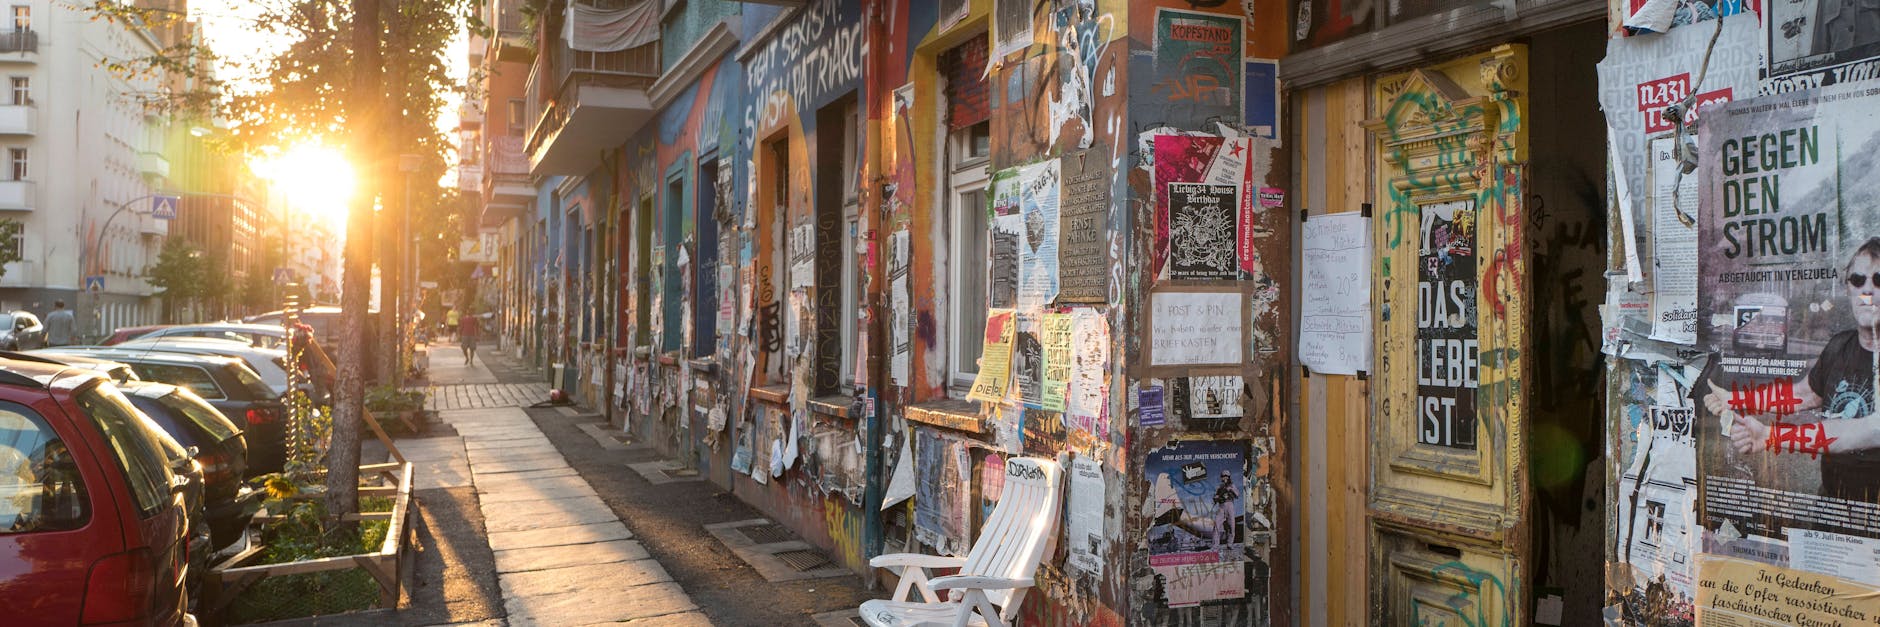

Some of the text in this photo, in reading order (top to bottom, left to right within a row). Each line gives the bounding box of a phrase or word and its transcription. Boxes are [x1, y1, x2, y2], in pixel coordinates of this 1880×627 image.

[1172, 25, 1230, 41] KOPFSTAND
[745, 72, 790, 149] SMASH
[1729, 106, 1750, 116] THOMAS
[1751, 104, 1773, 113] WALTER
[1838, 92, 1851, 101] FILM
[1722, 125, 1818, 176] GEGEN
[1723, 174, 1779, 217] DEN
[1072, 218, 1093, 231] ERNST
[1724, 212, 1827, 259] STROM
[1067, 230, 1097, 245] PAHNKE
[1719, 268, 1839, 284] ABGETAUCHT IN VENEZUELA
[1168, 303, 1192, 316] POST
[1207, 303, 1224, 316] PIN
[1419, 280, 1466, 328] DAS
[1154, 336, 1217, 349] BRIEFKASTEN
[1723, 365, 1739, 373] MANU
[1741, 366, 1755, 374] CHAO
[1742, 357, 1757, 366] CASH
[1758, 356, 1769, 367] FÜR
[1770, 359, 1786, 367] ARME
[1787, 360, 1807, 368] TRIFFT
[1418, 396, 1456, 446] IST
[1766, 421, 1839, 460] AREA
[1803, 530, 1812, 538] ab
[1814, 531, 1821, 539] 9.
[1822, 532, 1835, 540] Juli
[1846, 536, 1863, 544] Kino
[1732, 545, 1755, 555] THOMAS
[1757, 550, 1777, 560] WALTER
[1757, 569, 1835, 597] In Gedenken
[1700, 578, 1716, 589] an
[1722, 580, 1740, 594] die
[1745, 584, 1778, 603] Opfer
[1785, 597, 1866, 621] rassistischer
[1712, 594, 1792, 622] faschistischer
